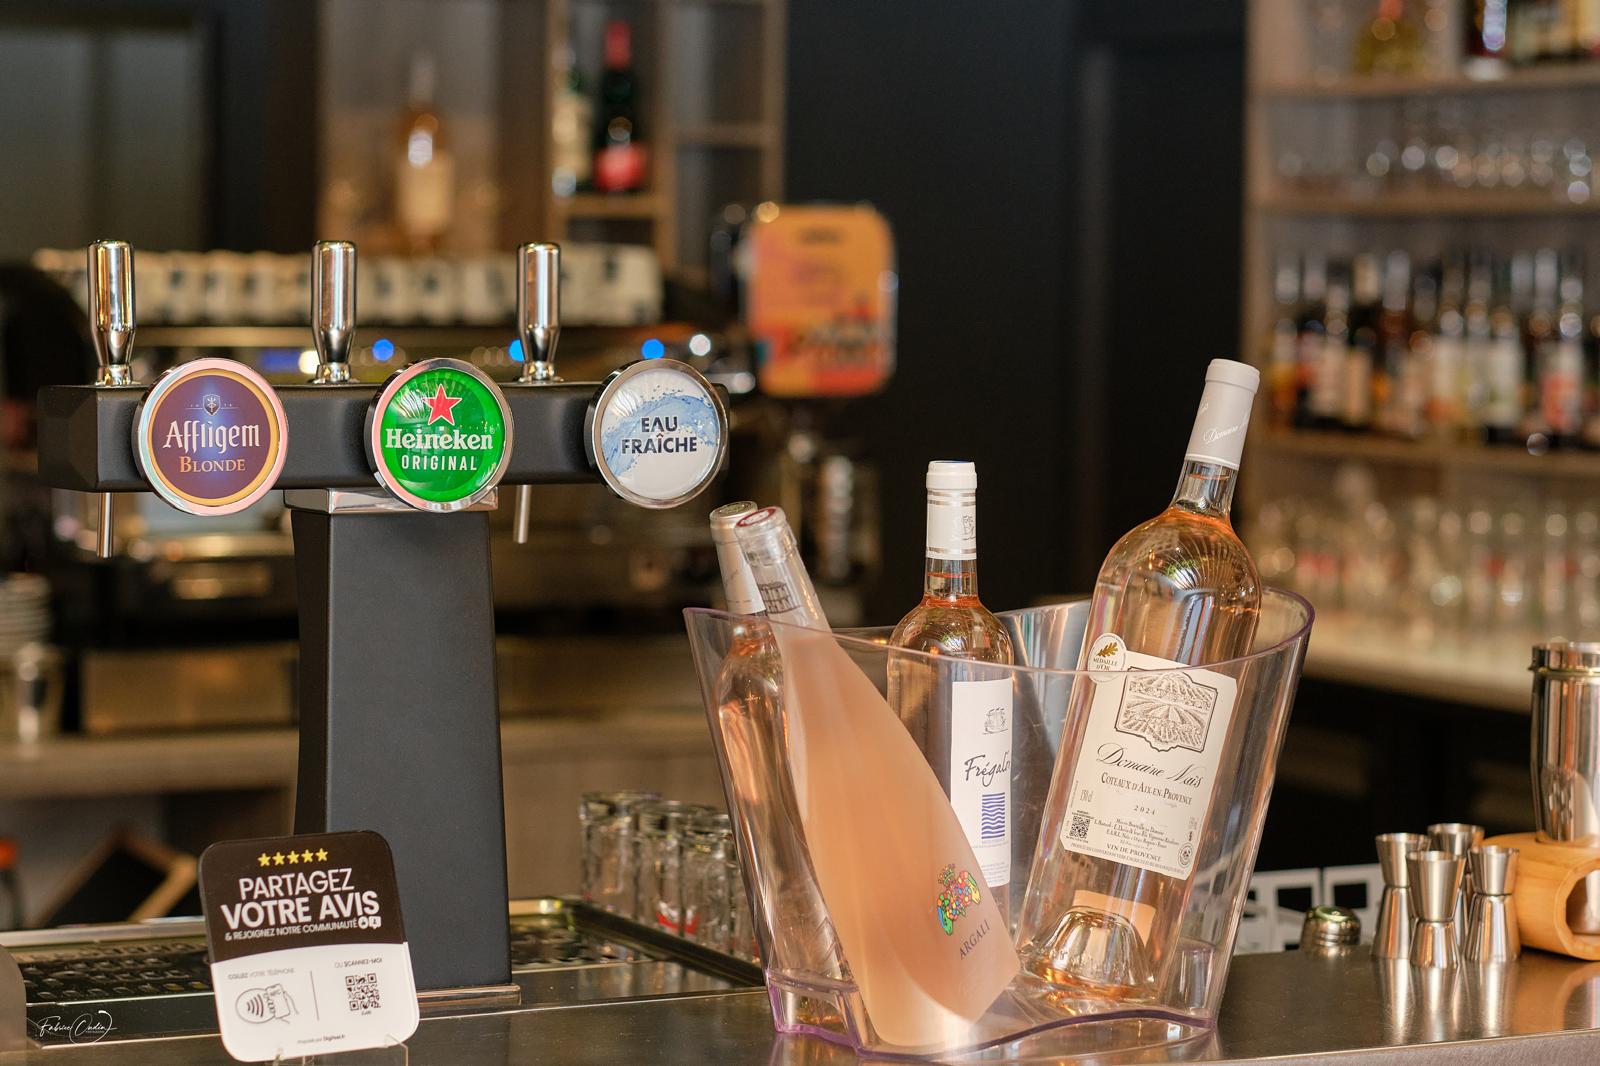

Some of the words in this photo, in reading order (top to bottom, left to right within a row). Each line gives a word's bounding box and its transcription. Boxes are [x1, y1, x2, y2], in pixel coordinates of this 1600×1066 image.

[641, 416, 678, 433] EAU
[162, 420, 261, 454] Affligem
[385, 428, 493, 450] Heineken
[621, 433, 697, 454] FRAÎCHE
[179, 456, 246, 473] BLONDE
[401, 455, 477, 471] ORIGINAL
[1096, 743, 1165, 777] Domaine
[239, 868, 355, 900] PARTAGEZ
[220, 897, 312, 930] VOTRE
[319, 890, 380, 920] AVIS
[225, 932, 233, 941] &
[233, 928, 275, 940] REJOIGNEZ
[276, 925, 301, 936] NOTRE
[302, 919, 358, 932] COMMUNAUTÉ
[959, 919, 990, 960] ARGALI
